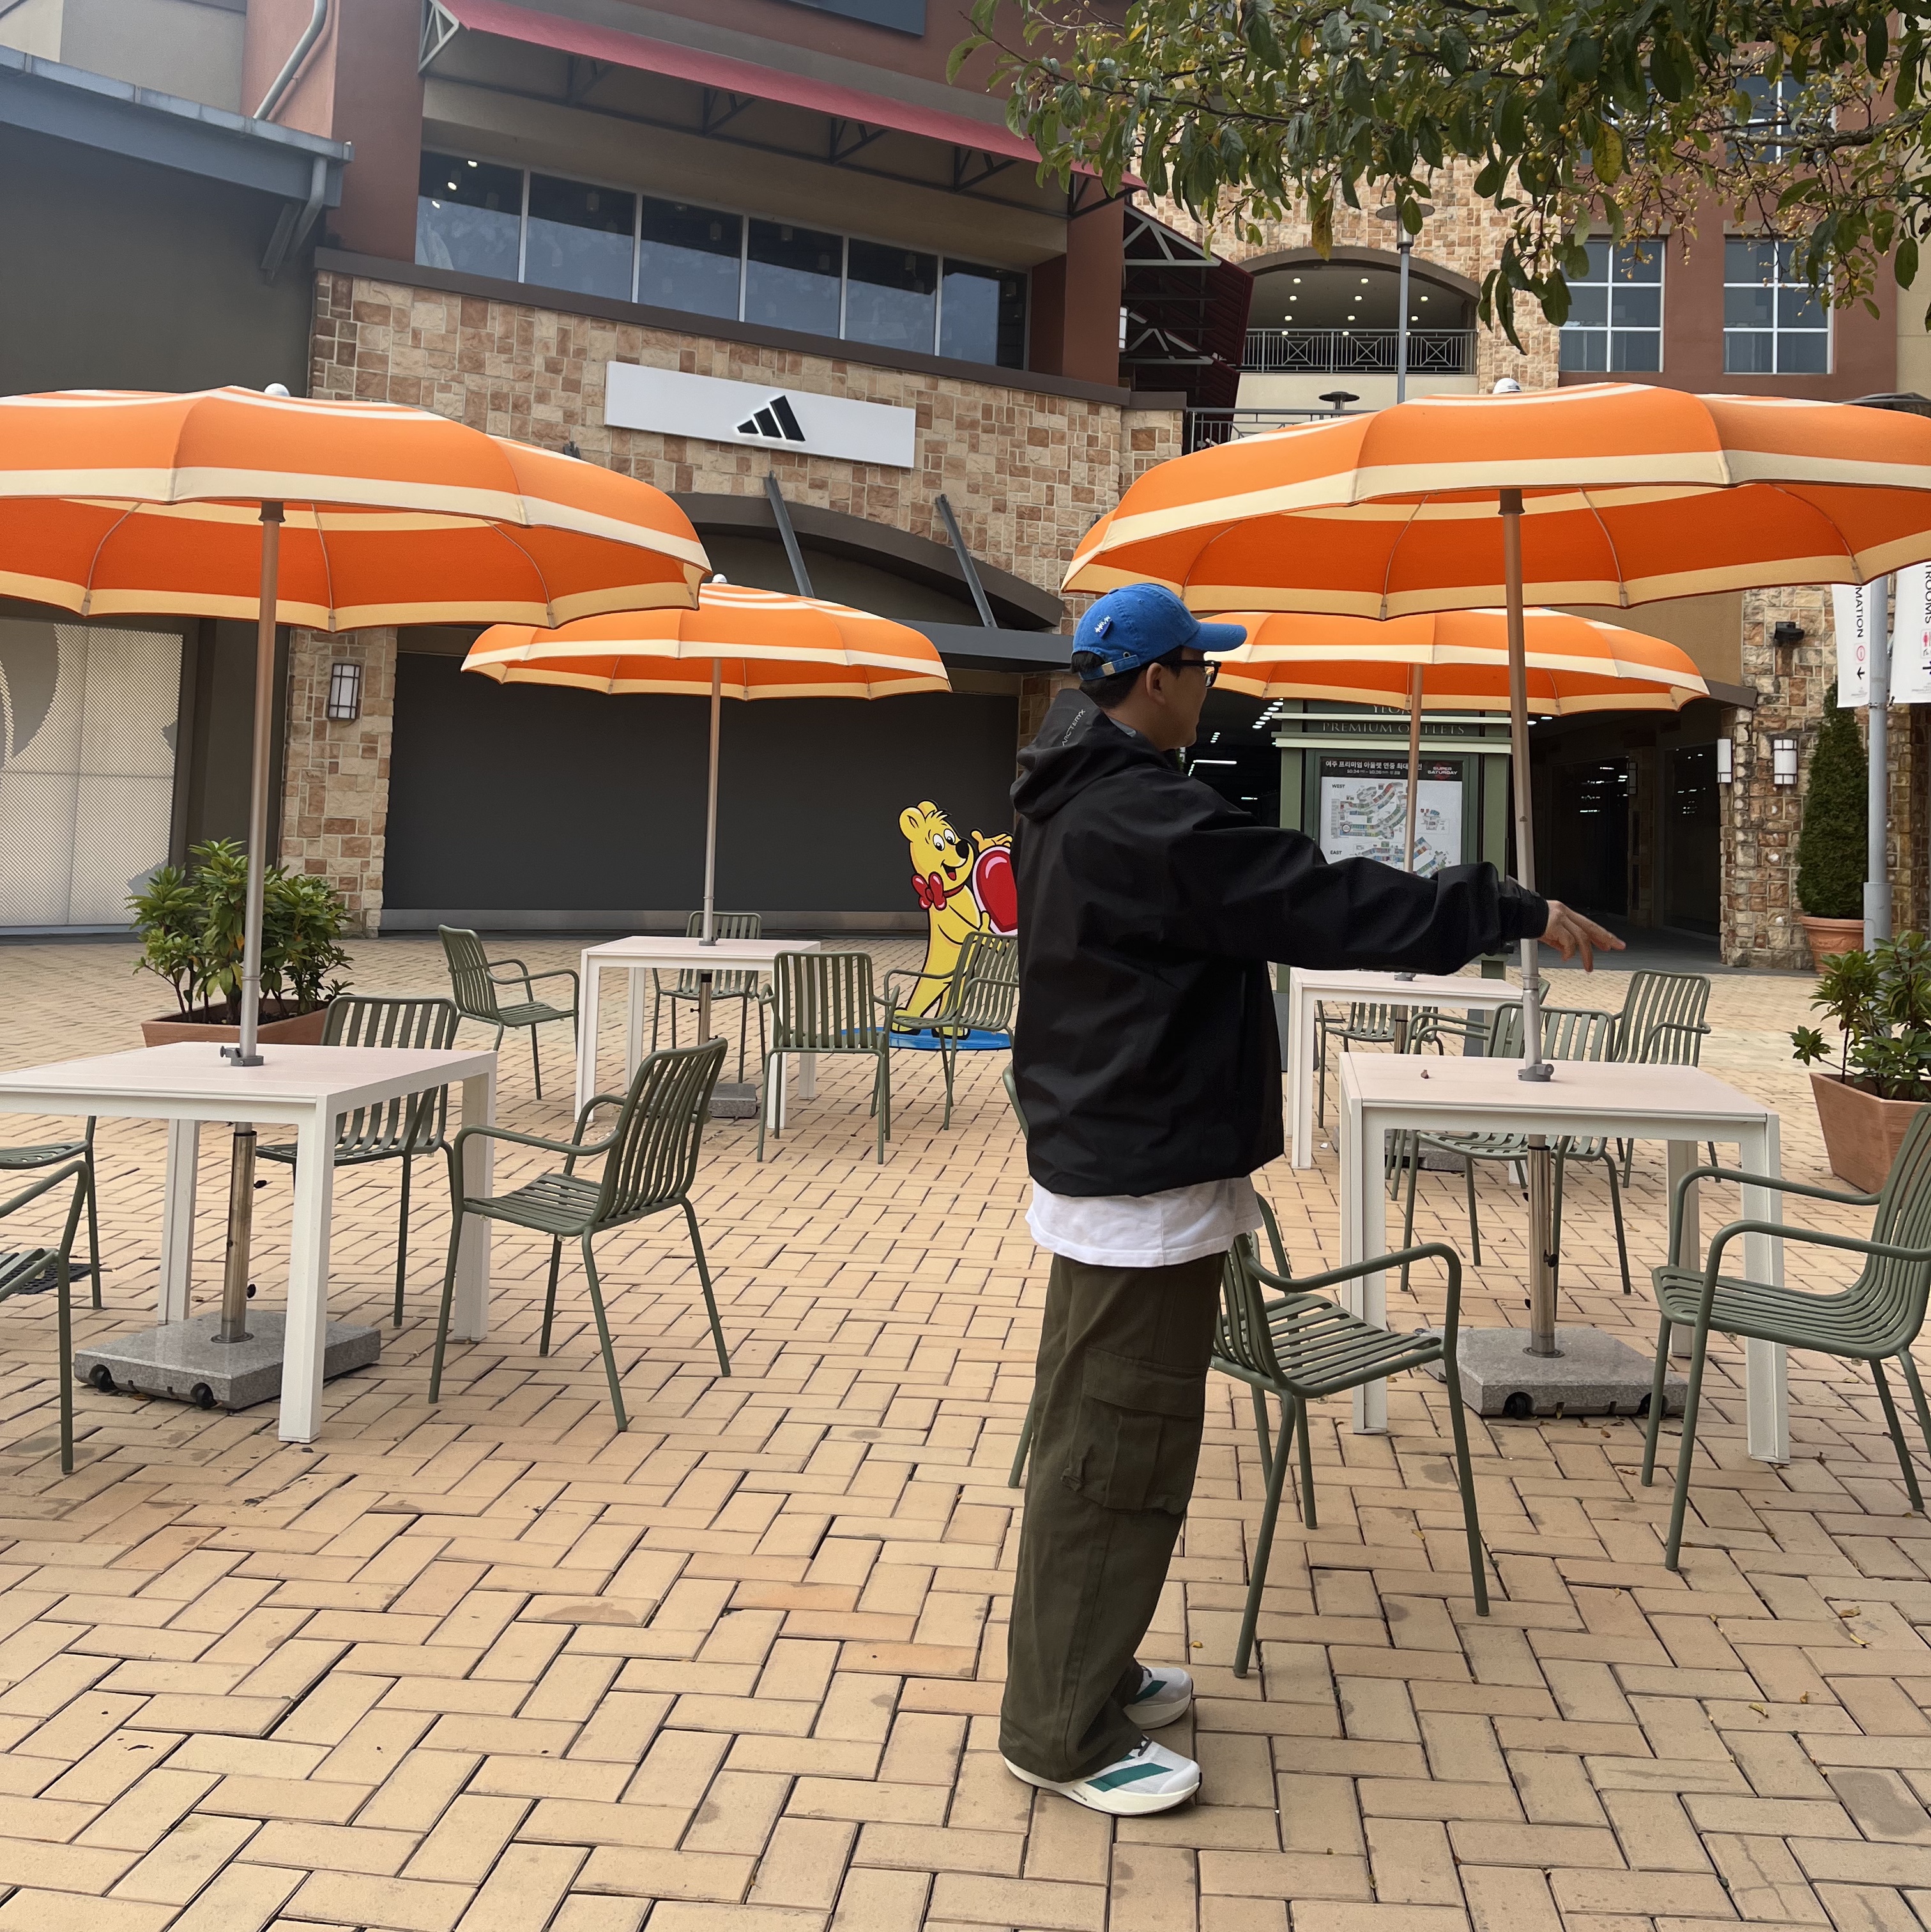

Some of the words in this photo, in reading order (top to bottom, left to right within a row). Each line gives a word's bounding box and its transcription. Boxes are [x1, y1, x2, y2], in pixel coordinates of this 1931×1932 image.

[1855, 586, 1863, 638] MATION
[1322, 722, 1393, 733] PREMIUM
[1398, 723, 1464, 735] OTLETS
